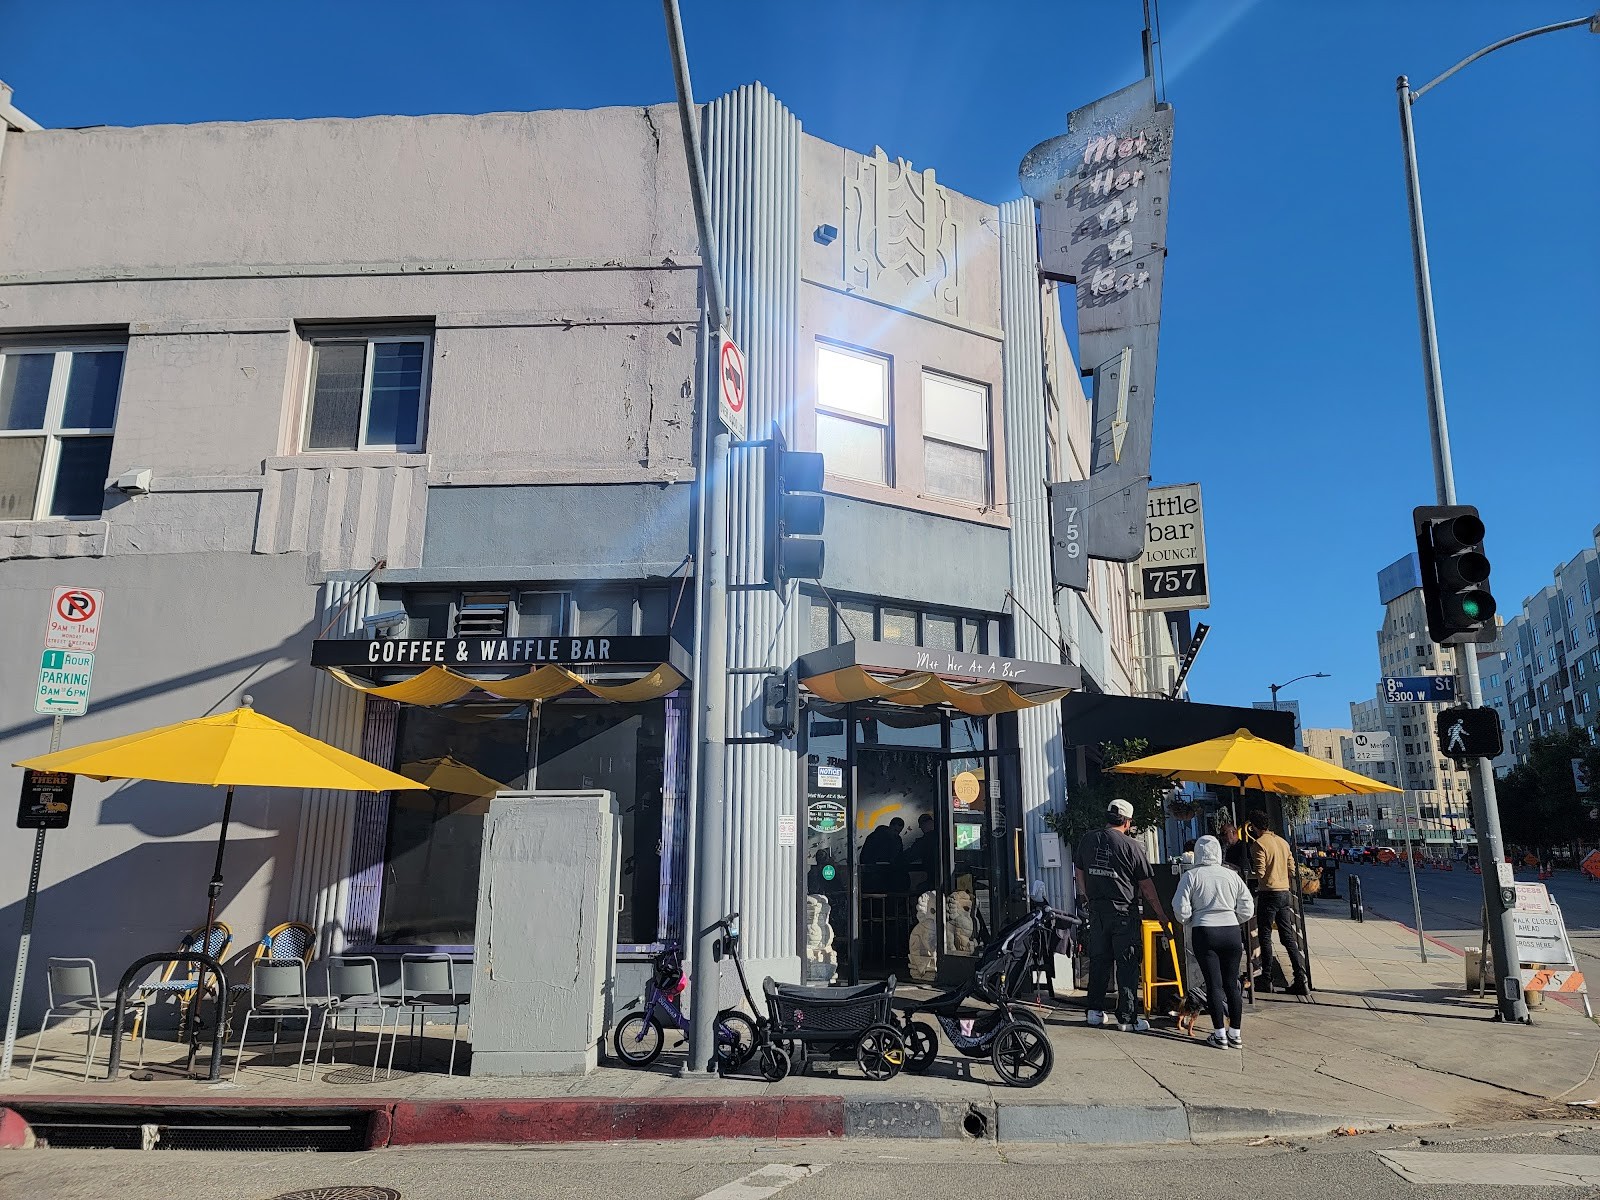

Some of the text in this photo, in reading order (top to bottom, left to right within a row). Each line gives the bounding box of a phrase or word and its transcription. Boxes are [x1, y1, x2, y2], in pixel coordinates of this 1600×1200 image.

[1084, 130, 1147, 164] Met
[1090, 168, 1145, 196] Her
[1099, 196, 1139, 230] At
[1107, 228, 1134, 261] A
[1090, 266, 1151, 296] Bar
[1146, 495, 1199, 519] ittle
[1065, 507, 1080, 559] 759
[1147, 522, 1194, 543] bar
[1147, 547, 1197, 562] LOUNGE
[1150, 569, 1197, 593] 757
[51, 621, 68, 632] 9AM
[78, 624, 95, 635] 11AM
[368, 638, 611, 662] COFFEE & WAFFLE BAR
[50, 652, 90, 667] 1 HOUR
[916, 652, 1026, 678] Met Her At A Bar
[41, 671, 89, 686] PARKING
[1387, 676, 1452, 692] 8th St
[40, 685, 60, 696] 8AM
[66, 687, 86, 697] 6PM
[1388, 691, 1426, 702] 5300 W
[819, 768, 841, 776] NOTICE
[31, 776, 68, 784] THERE
[957, 786, 977, 795] OPEN
[957, 830, 972, 845] A
[1516, 886, 1542, 894] CCESS
[1532, 917, 1558, 926] CLOSED
[1534, 973, 1563, 986] STS
